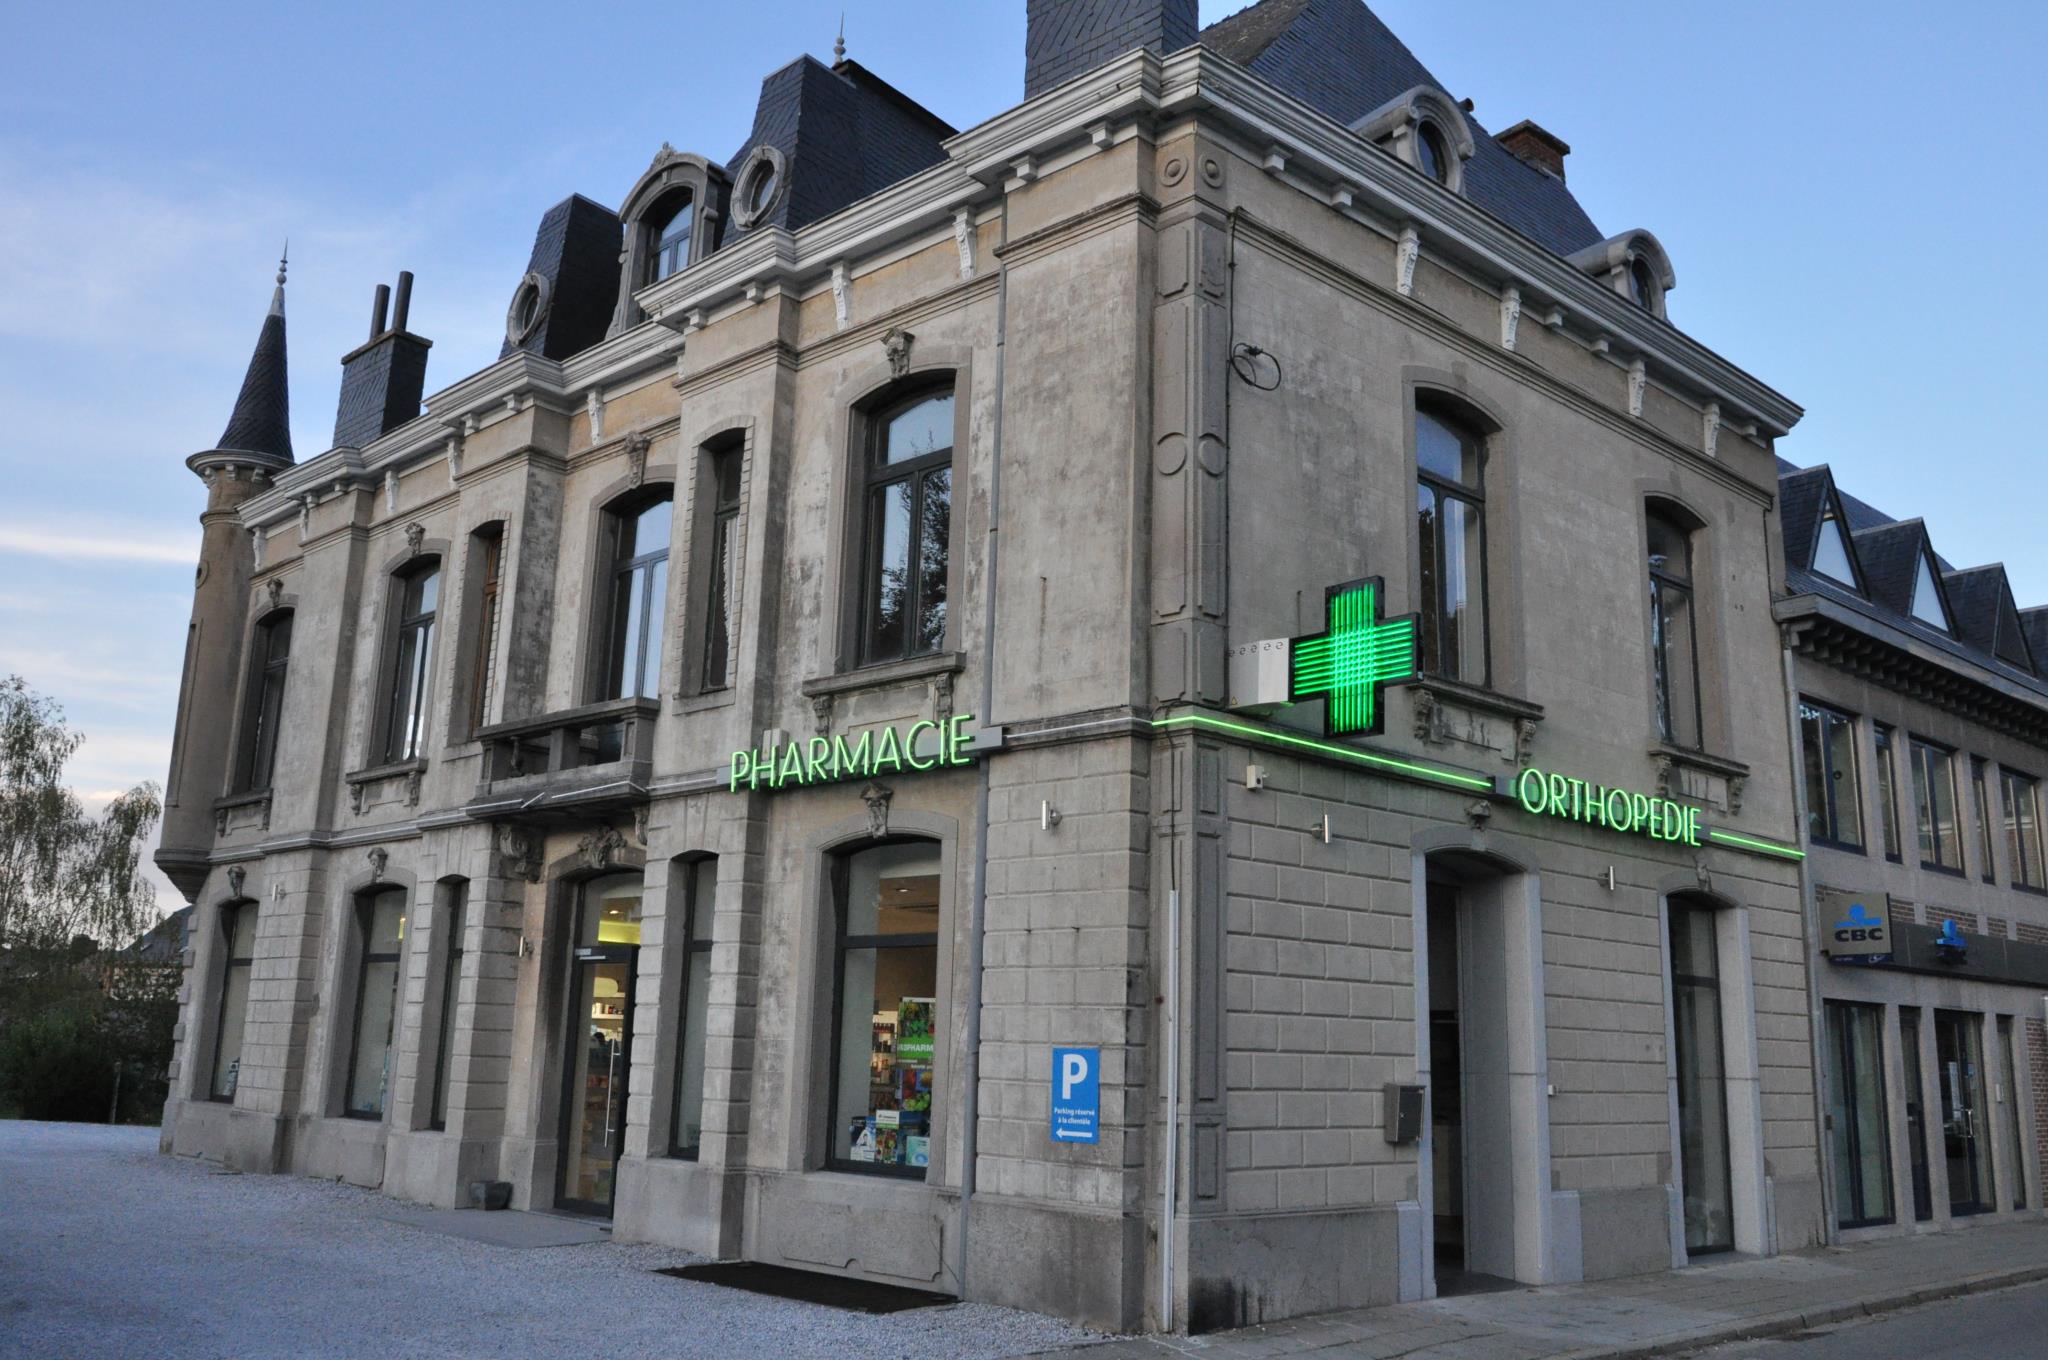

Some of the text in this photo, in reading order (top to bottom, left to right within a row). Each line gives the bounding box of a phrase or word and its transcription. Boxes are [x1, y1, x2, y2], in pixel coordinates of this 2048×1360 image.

[730, 714, 973, 793] PHARMACIE
[1519, 768, 1702, 847] ORTHOPEDIE
[1834, 927, 1883, 942] CBC
[1062, 1053, 1088, 1100] P
[1054, 1107, 1074, 1116] Parking
